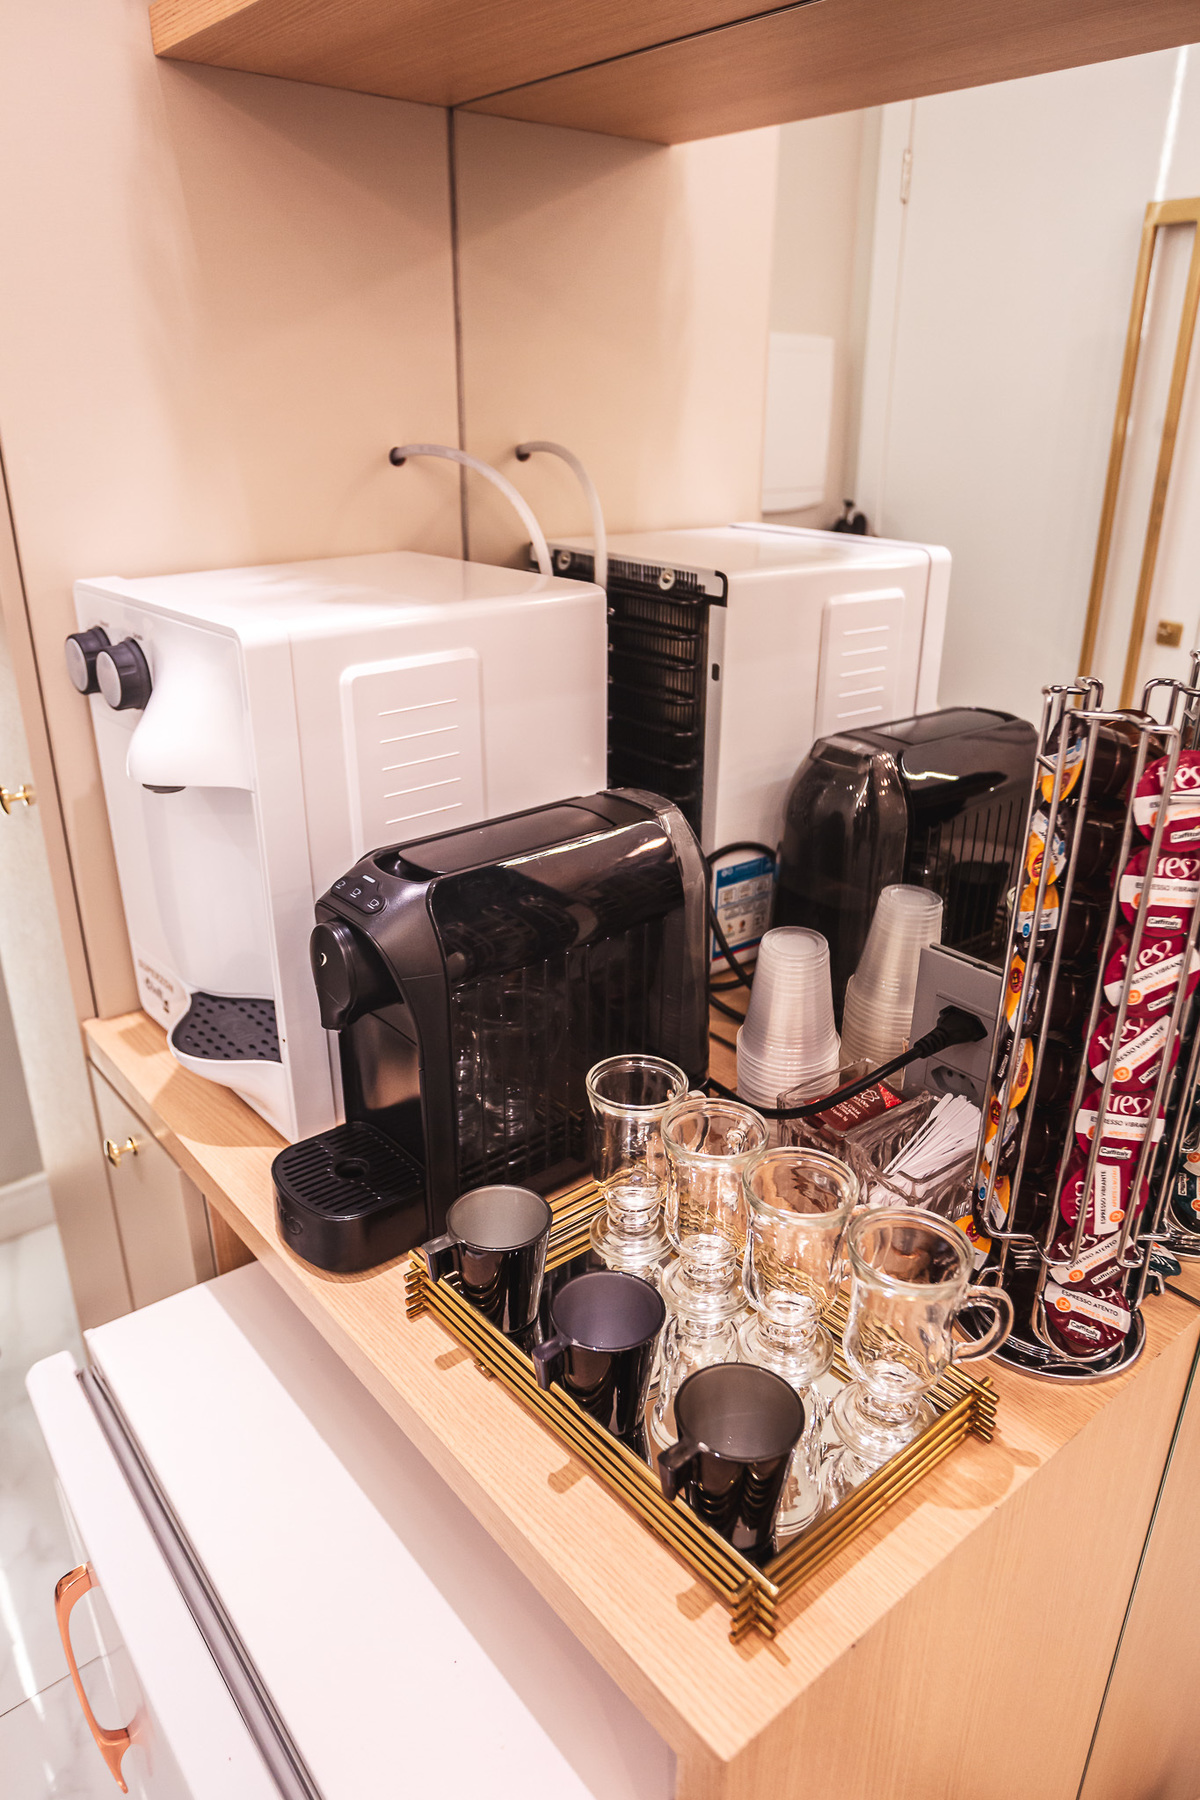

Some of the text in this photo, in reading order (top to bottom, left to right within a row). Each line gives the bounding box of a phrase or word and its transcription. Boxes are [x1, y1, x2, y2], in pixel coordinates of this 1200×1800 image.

[1100, 1147, 1129, 1157] Caffitaly
[1094, 1240, 1118, 1255] ATENTO
[1092, 1267, 1119, 1284] Caffitaly
[1062, 1290, 1092, 1306] ESPRESSO
[1093, 1303, 1119, 1317] ATENTO
[1070, 1321, 1098, 1338] Caffitaly
